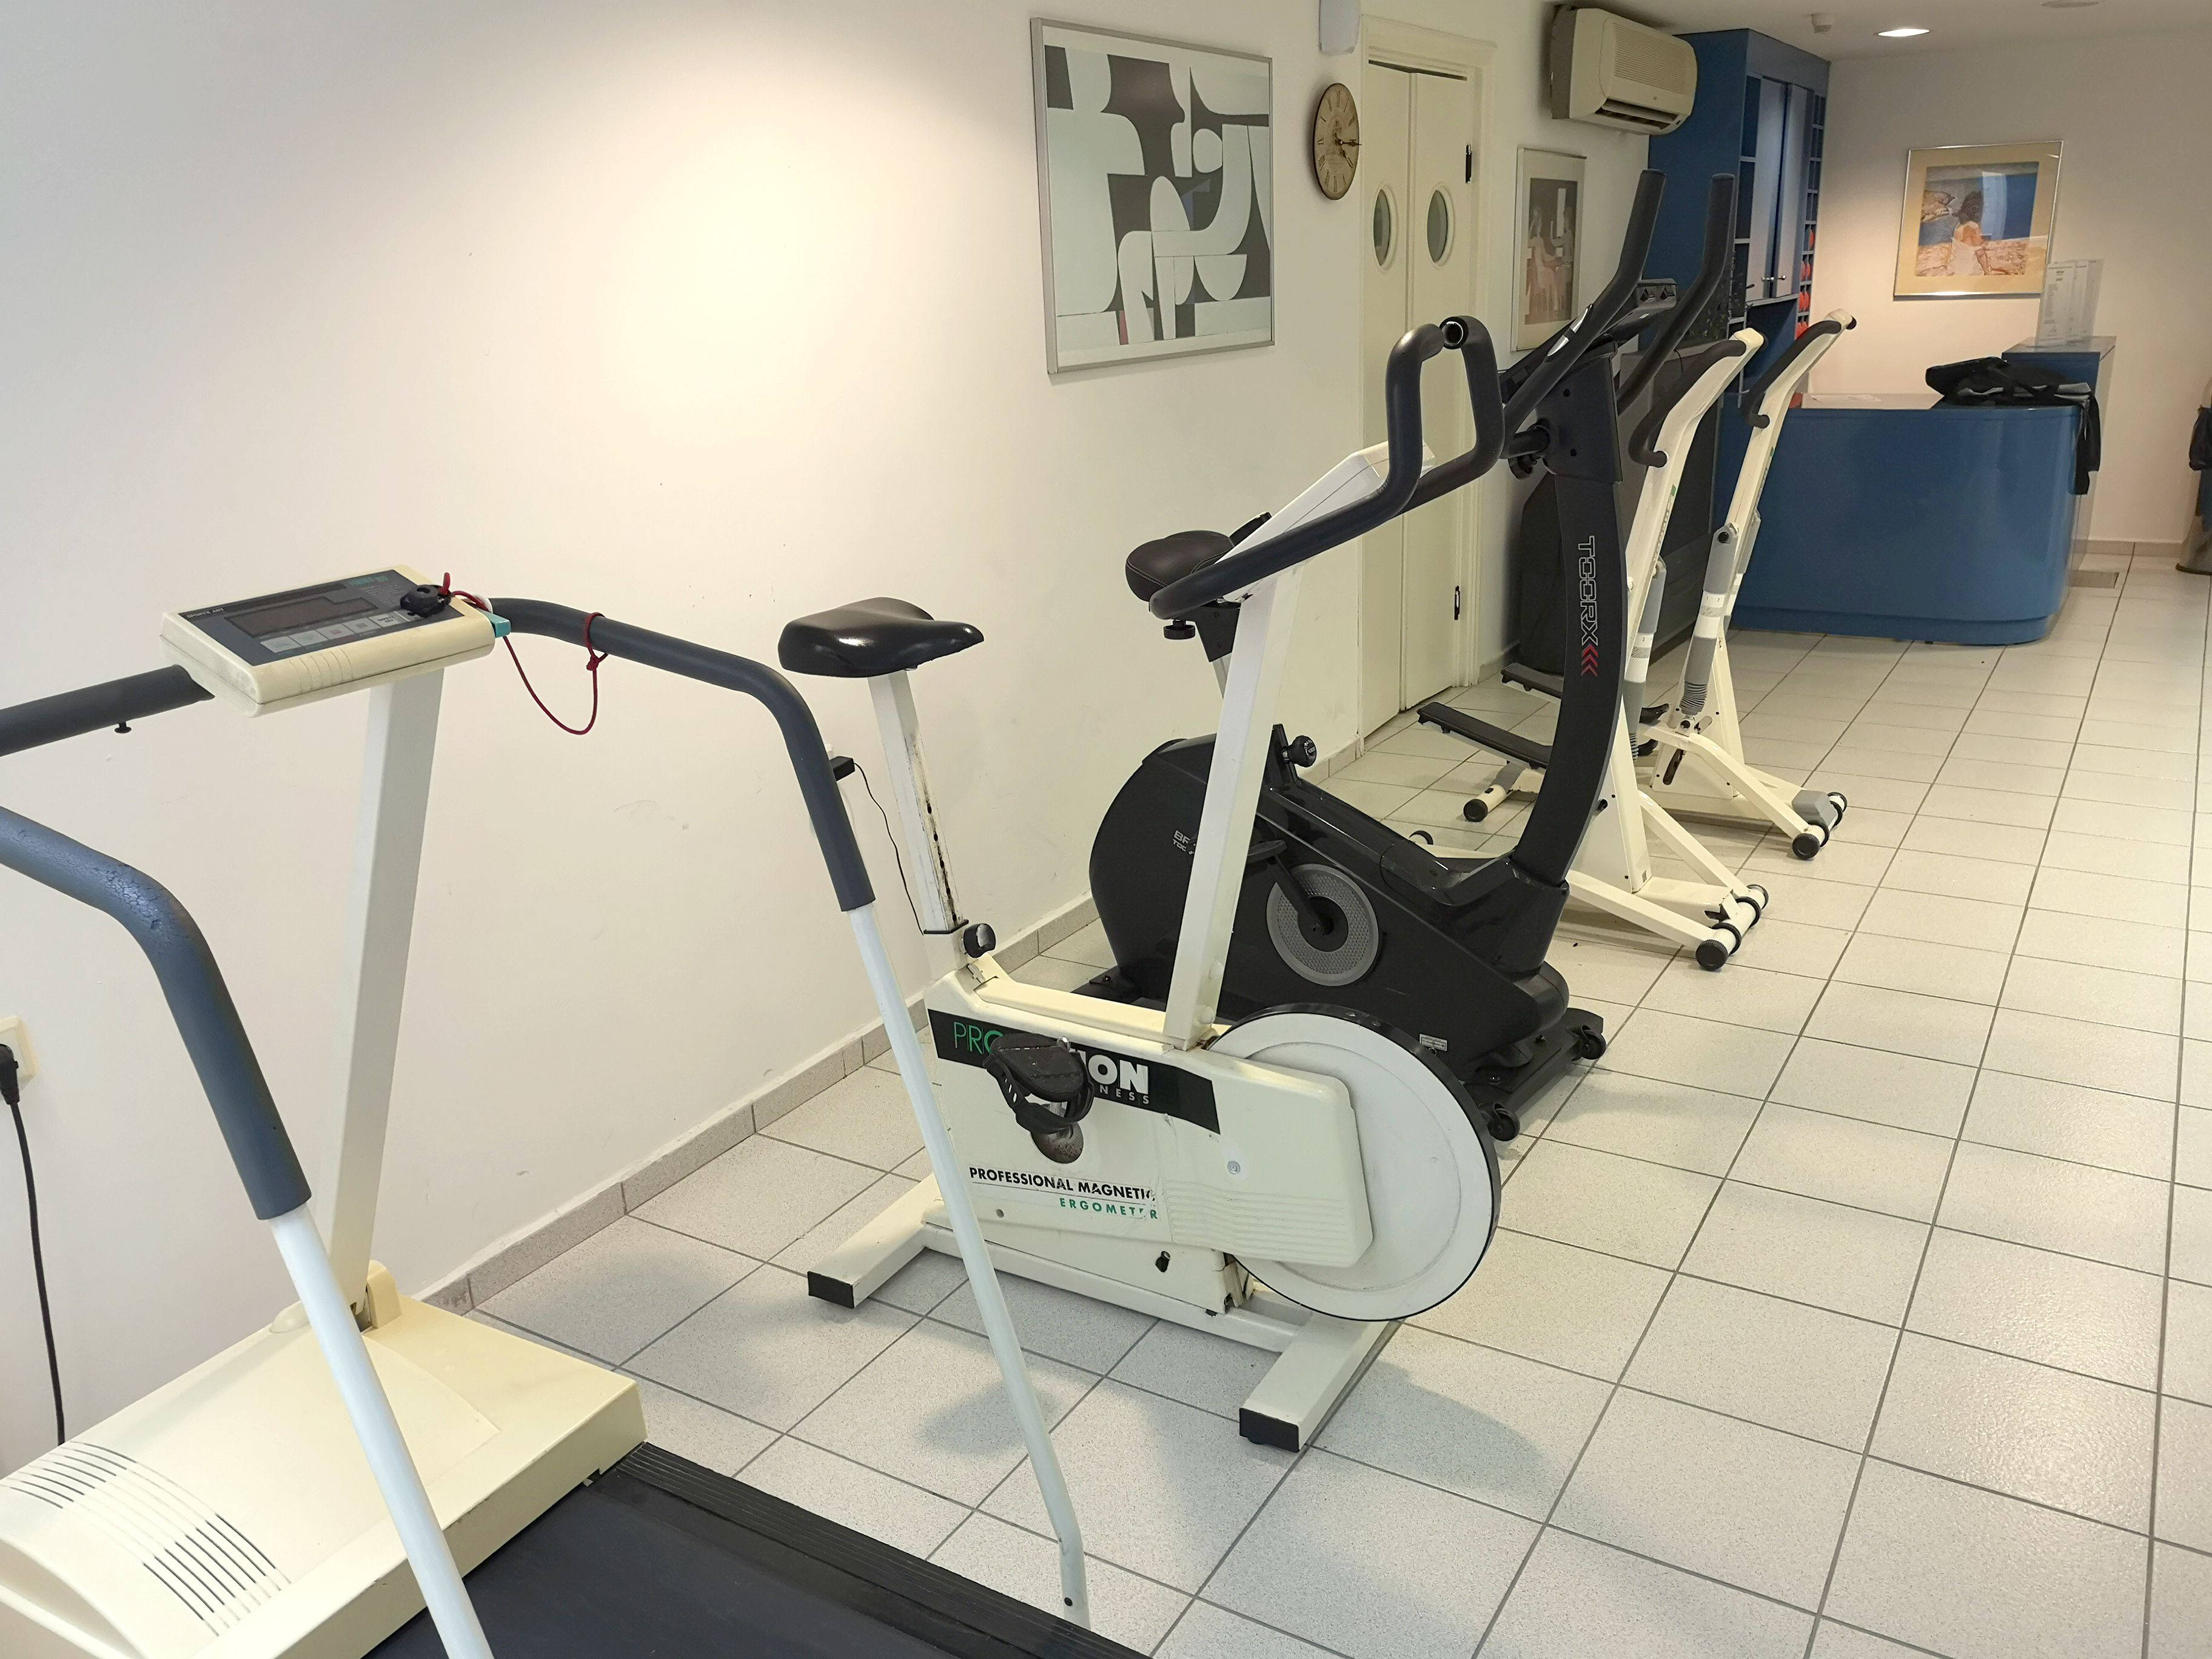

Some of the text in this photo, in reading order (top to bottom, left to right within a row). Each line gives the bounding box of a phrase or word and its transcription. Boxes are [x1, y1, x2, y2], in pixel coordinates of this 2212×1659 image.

[1578, 535, 1599, 646] TOORX
[1099, 1084, 1150, 1105] NESS
[969, 1167, 1074, 1191] PROFESSIONAL
[1059, 1197, 1159, 1219] ERGOMETR
